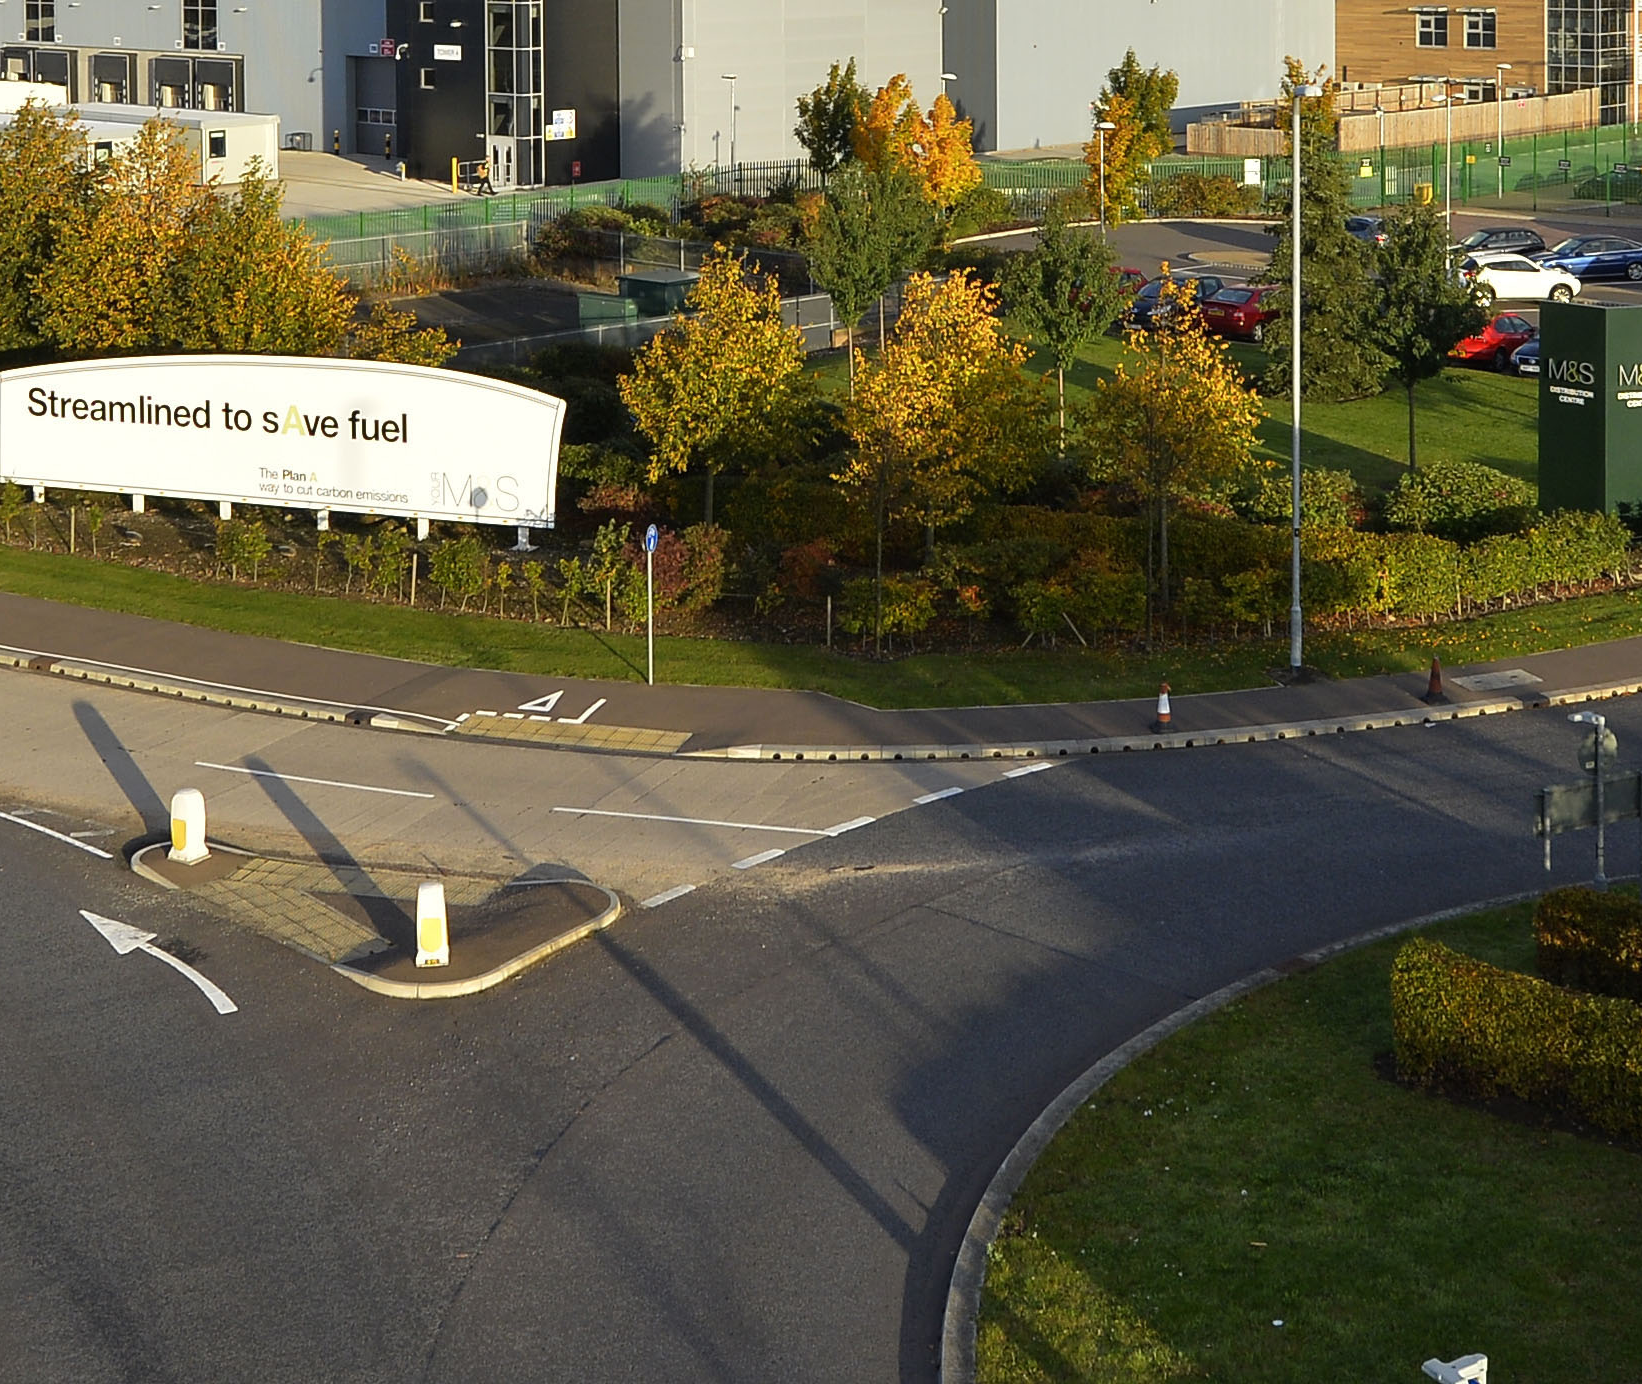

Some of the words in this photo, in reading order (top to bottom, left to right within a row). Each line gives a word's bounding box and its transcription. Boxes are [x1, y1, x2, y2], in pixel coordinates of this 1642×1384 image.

[1548, 358, 1595, 385] M&S
[1559, 395, 1585, 406] CENTRE
[27, 387, 211, 429] Streamlined
[223, 401, 253, 432] to
[261, 404, 339, 439] sAve
[348, 410, 409, 444] fuel
[259, 467, 278, 480] The
[282, 469, 307, 482] Plan
[310, 472, 318, 482] A
[259, 483, 280, 496] way
[283, 484, 294, 494] to
[297, 484, 313, 496] cut
[316, 486, 353, 499] carbon
[356, 489, 409, 504] emissions
